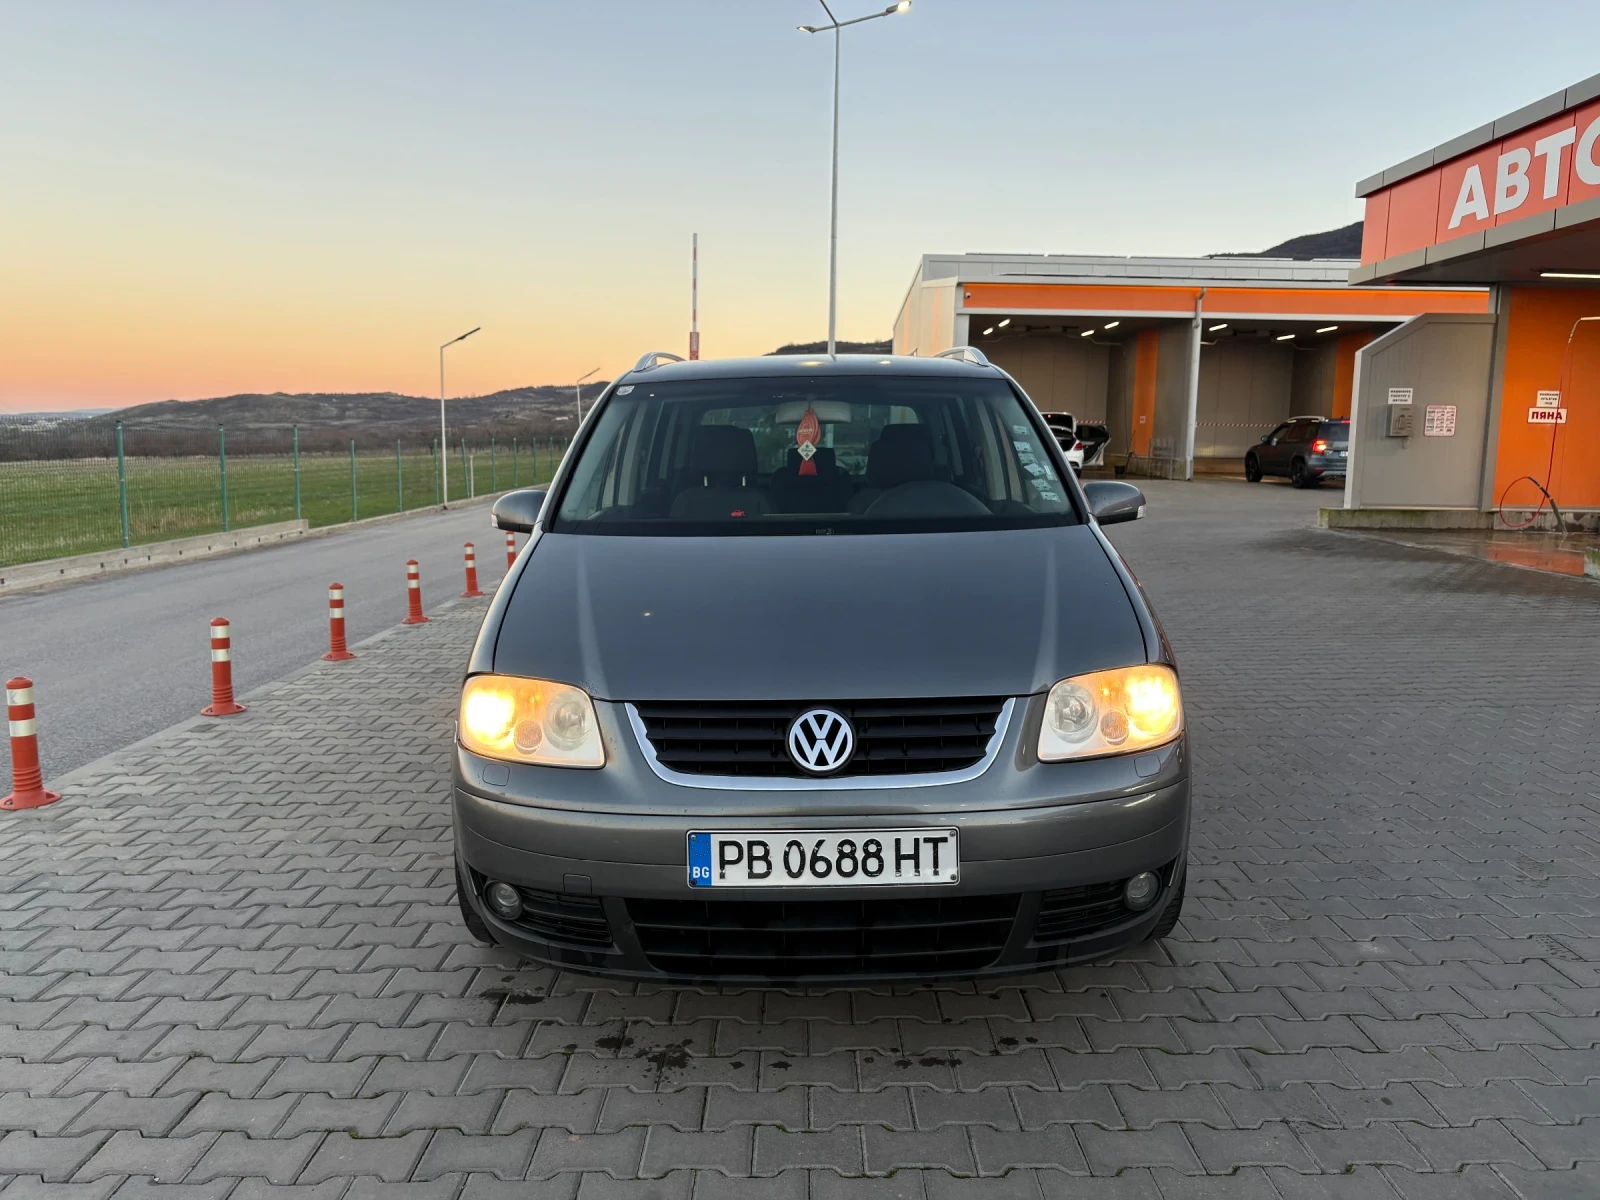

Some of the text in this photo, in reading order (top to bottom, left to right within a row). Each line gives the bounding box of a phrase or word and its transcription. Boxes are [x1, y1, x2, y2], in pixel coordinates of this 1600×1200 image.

[1531, 411, 1563, 420] ПЯНА
[718, 836, 949, 880] PB 0688 HT
[693, 866, 710, 878] BG
